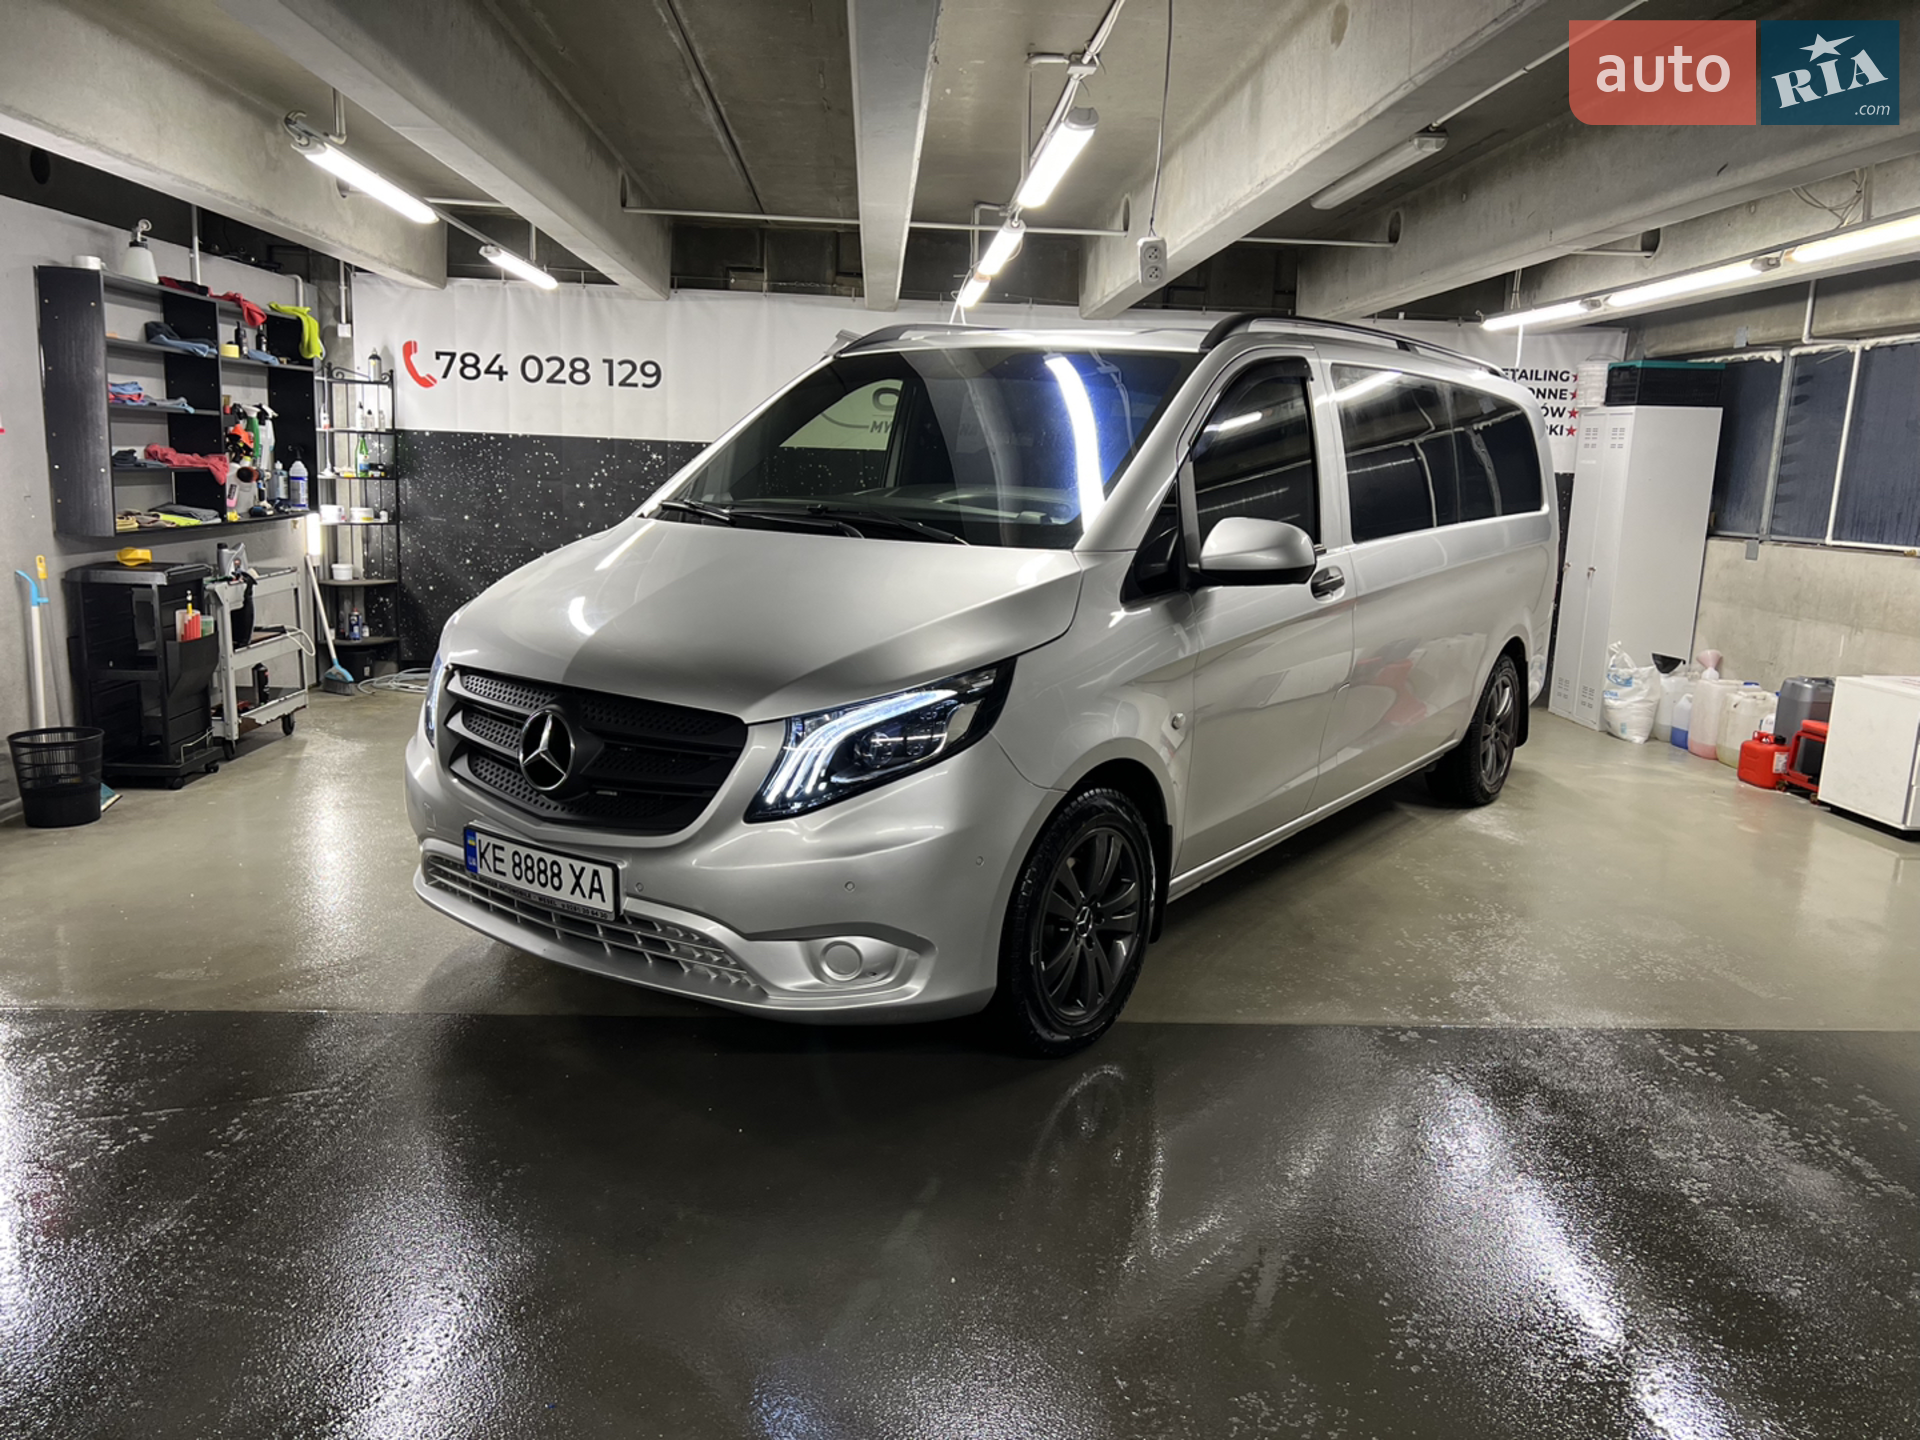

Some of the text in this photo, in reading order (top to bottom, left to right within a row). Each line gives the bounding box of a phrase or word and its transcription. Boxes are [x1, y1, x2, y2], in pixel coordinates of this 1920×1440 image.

[435, 350, 662, 388] 784 028 129
[1547, 424, 1564, 436] KI
[478, 839, 606, 903] KE 8888 XA
